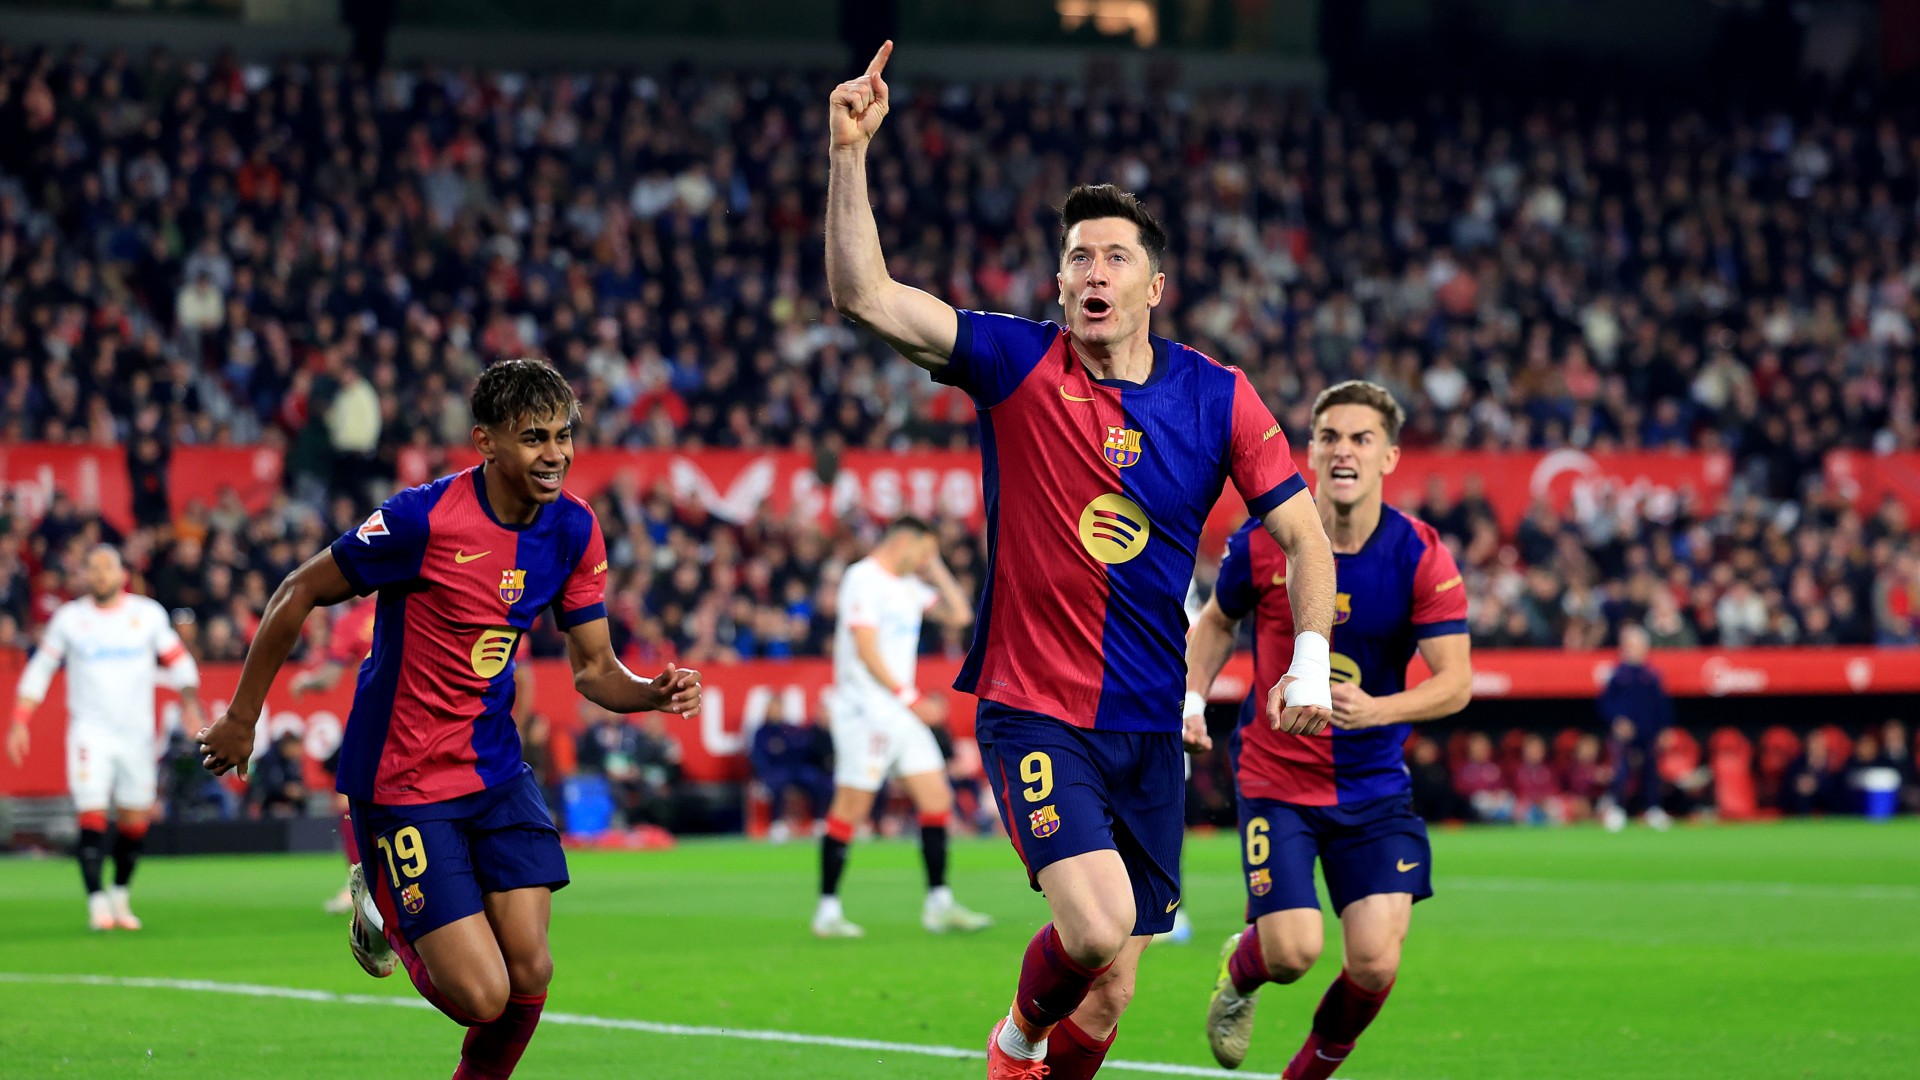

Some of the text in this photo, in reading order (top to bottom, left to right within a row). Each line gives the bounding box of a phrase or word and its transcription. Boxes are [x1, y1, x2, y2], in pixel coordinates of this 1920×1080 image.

[1020, 751, 1053, 802] 9
[377, 826, 427, 888] 19
[1246, 816, 1270, 866] 6
